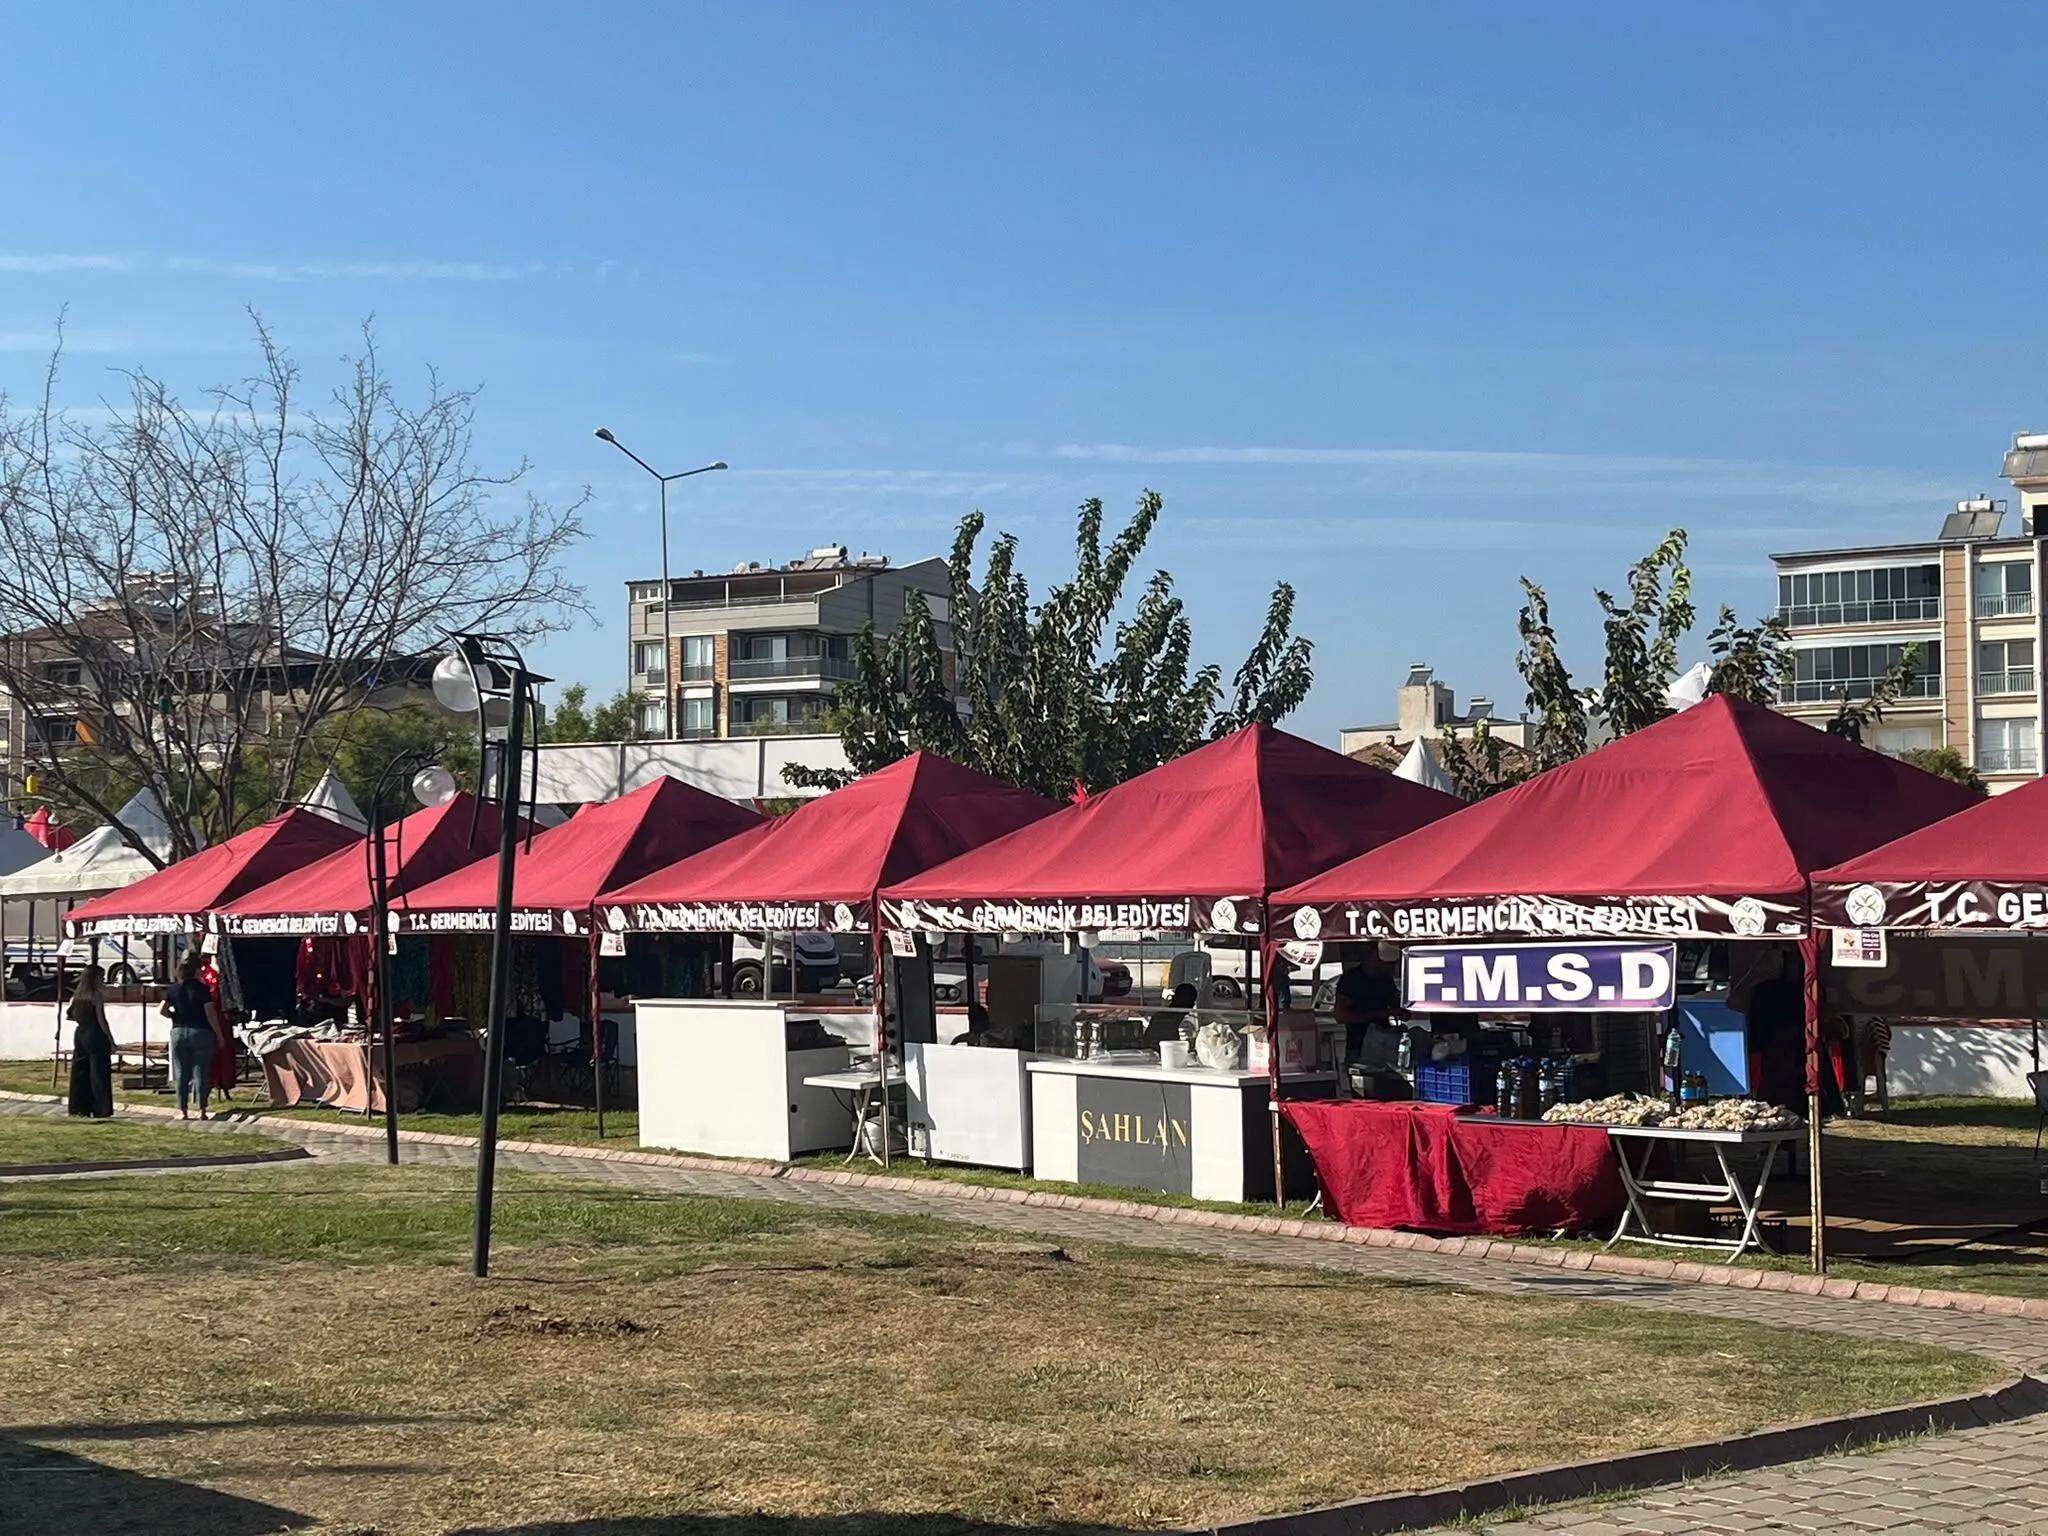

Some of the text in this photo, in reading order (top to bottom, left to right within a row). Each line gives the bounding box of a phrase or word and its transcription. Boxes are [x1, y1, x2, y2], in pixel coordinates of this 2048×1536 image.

[409, 908, 552, 931] T.C. GERMENCİK EDİYESİ
[740, 902, 820, 927] BELEDİYESİ
[972, 899, 1076, 928] GERMENCİK
[1080, 898, 1191, 927] BELEDİYESİ
[1345, 900, 1699, 935] T.C. GERMENCİK BELEDİYESİ
[1925, 892, 2048, 923] T.C. GE
[1408, 952, 1671, 1001] F.M.S.D
[1081, 1110, 1187, 1148] ŞAHLAN
